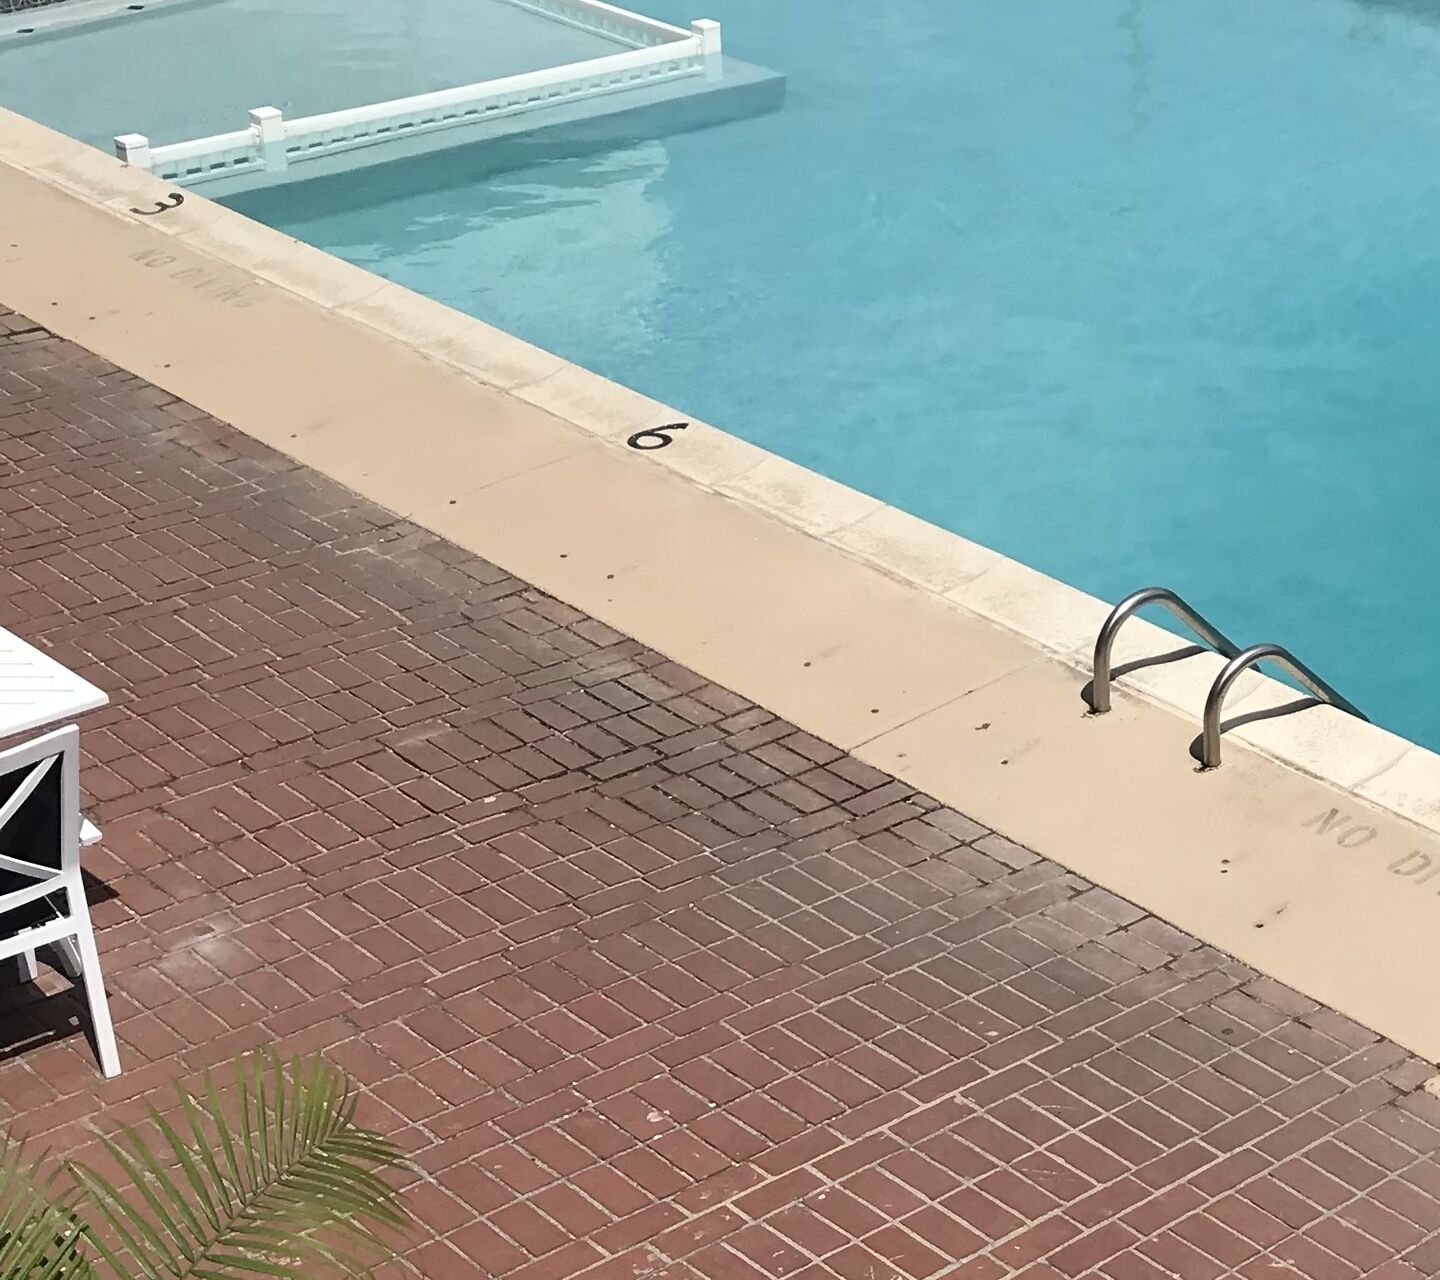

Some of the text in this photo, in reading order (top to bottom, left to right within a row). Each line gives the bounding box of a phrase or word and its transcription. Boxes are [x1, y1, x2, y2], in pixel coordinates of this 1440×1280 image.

[129, 193, 184, 215] 3
[627, 422, 689, 450] 6
[1301, 808, 1377, 848] NO
